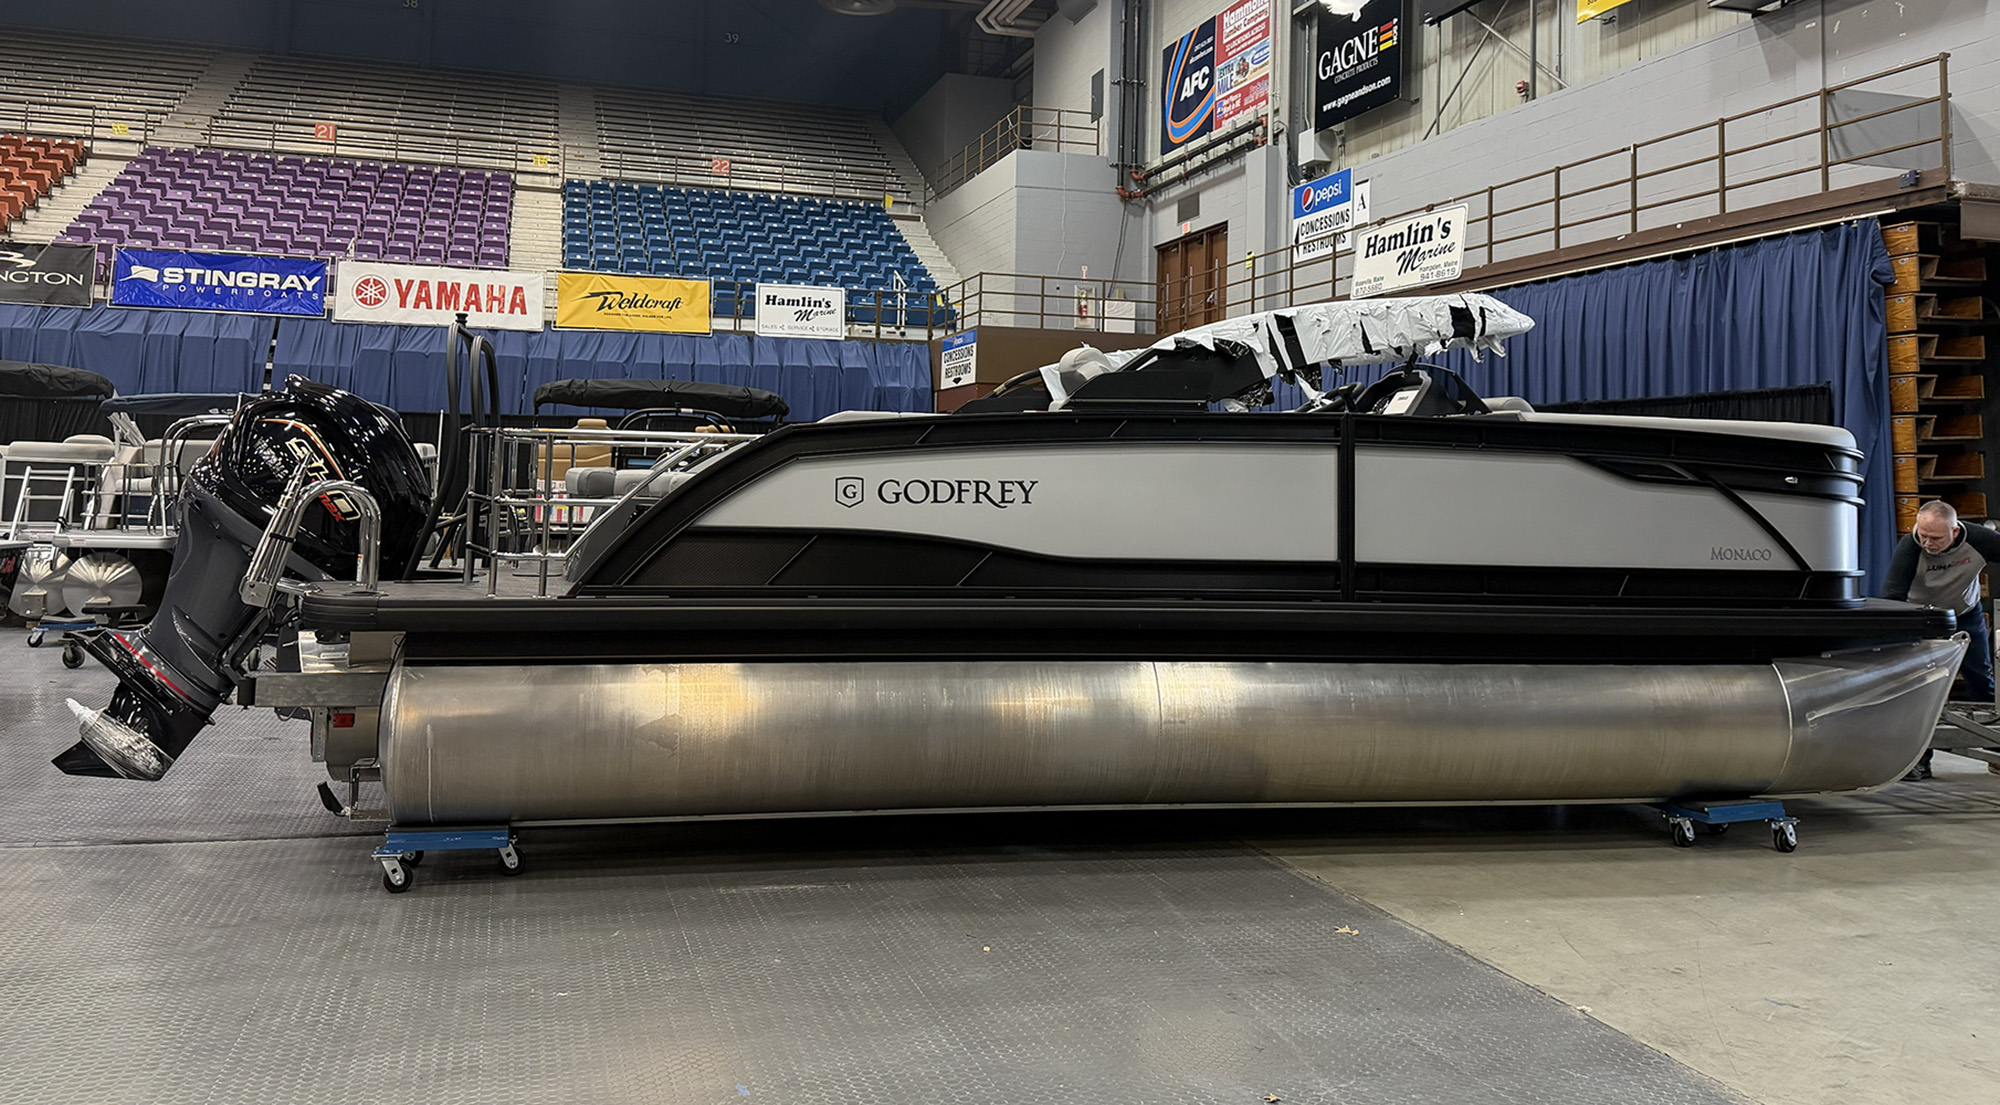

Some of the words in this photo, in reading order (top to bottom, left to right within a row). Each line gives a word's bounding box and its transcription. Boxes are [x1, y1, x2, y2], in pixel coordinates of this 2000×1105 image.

[725, 32, 739, 43] 39
[1318, 26, 1379, 80] GAGNE
[1356, 57, 1379, 74] PRODUCTS
[1180, 65, 1210, 102] AFC
[1322, 75, 1392, 112] www.gagneandson.com
[317, 124, 333, 139] 21
[712, 160, 730, 173] 22
[1314, 178, 1342, 207] pepsi
[1357, 192, 1367, 212] A
[1300, 208, 1350, 237] CONCESSIONS
[1363, 216, 1452, 259] Hamlin's
[1396, 241, 1456, 276] Marine
[163, 267, 321, 292] STINGRAY
[163, 284, 319, 300] POWERBOATS
[393, 278, 528, 316] YAMAHA
[588, 291, 684, 313] Weldcraft
[765, 294, 832, 309] Hamlin's
[793, 308, 837, 323] Marine
[877, 479, 1039, 509] GODFREY
